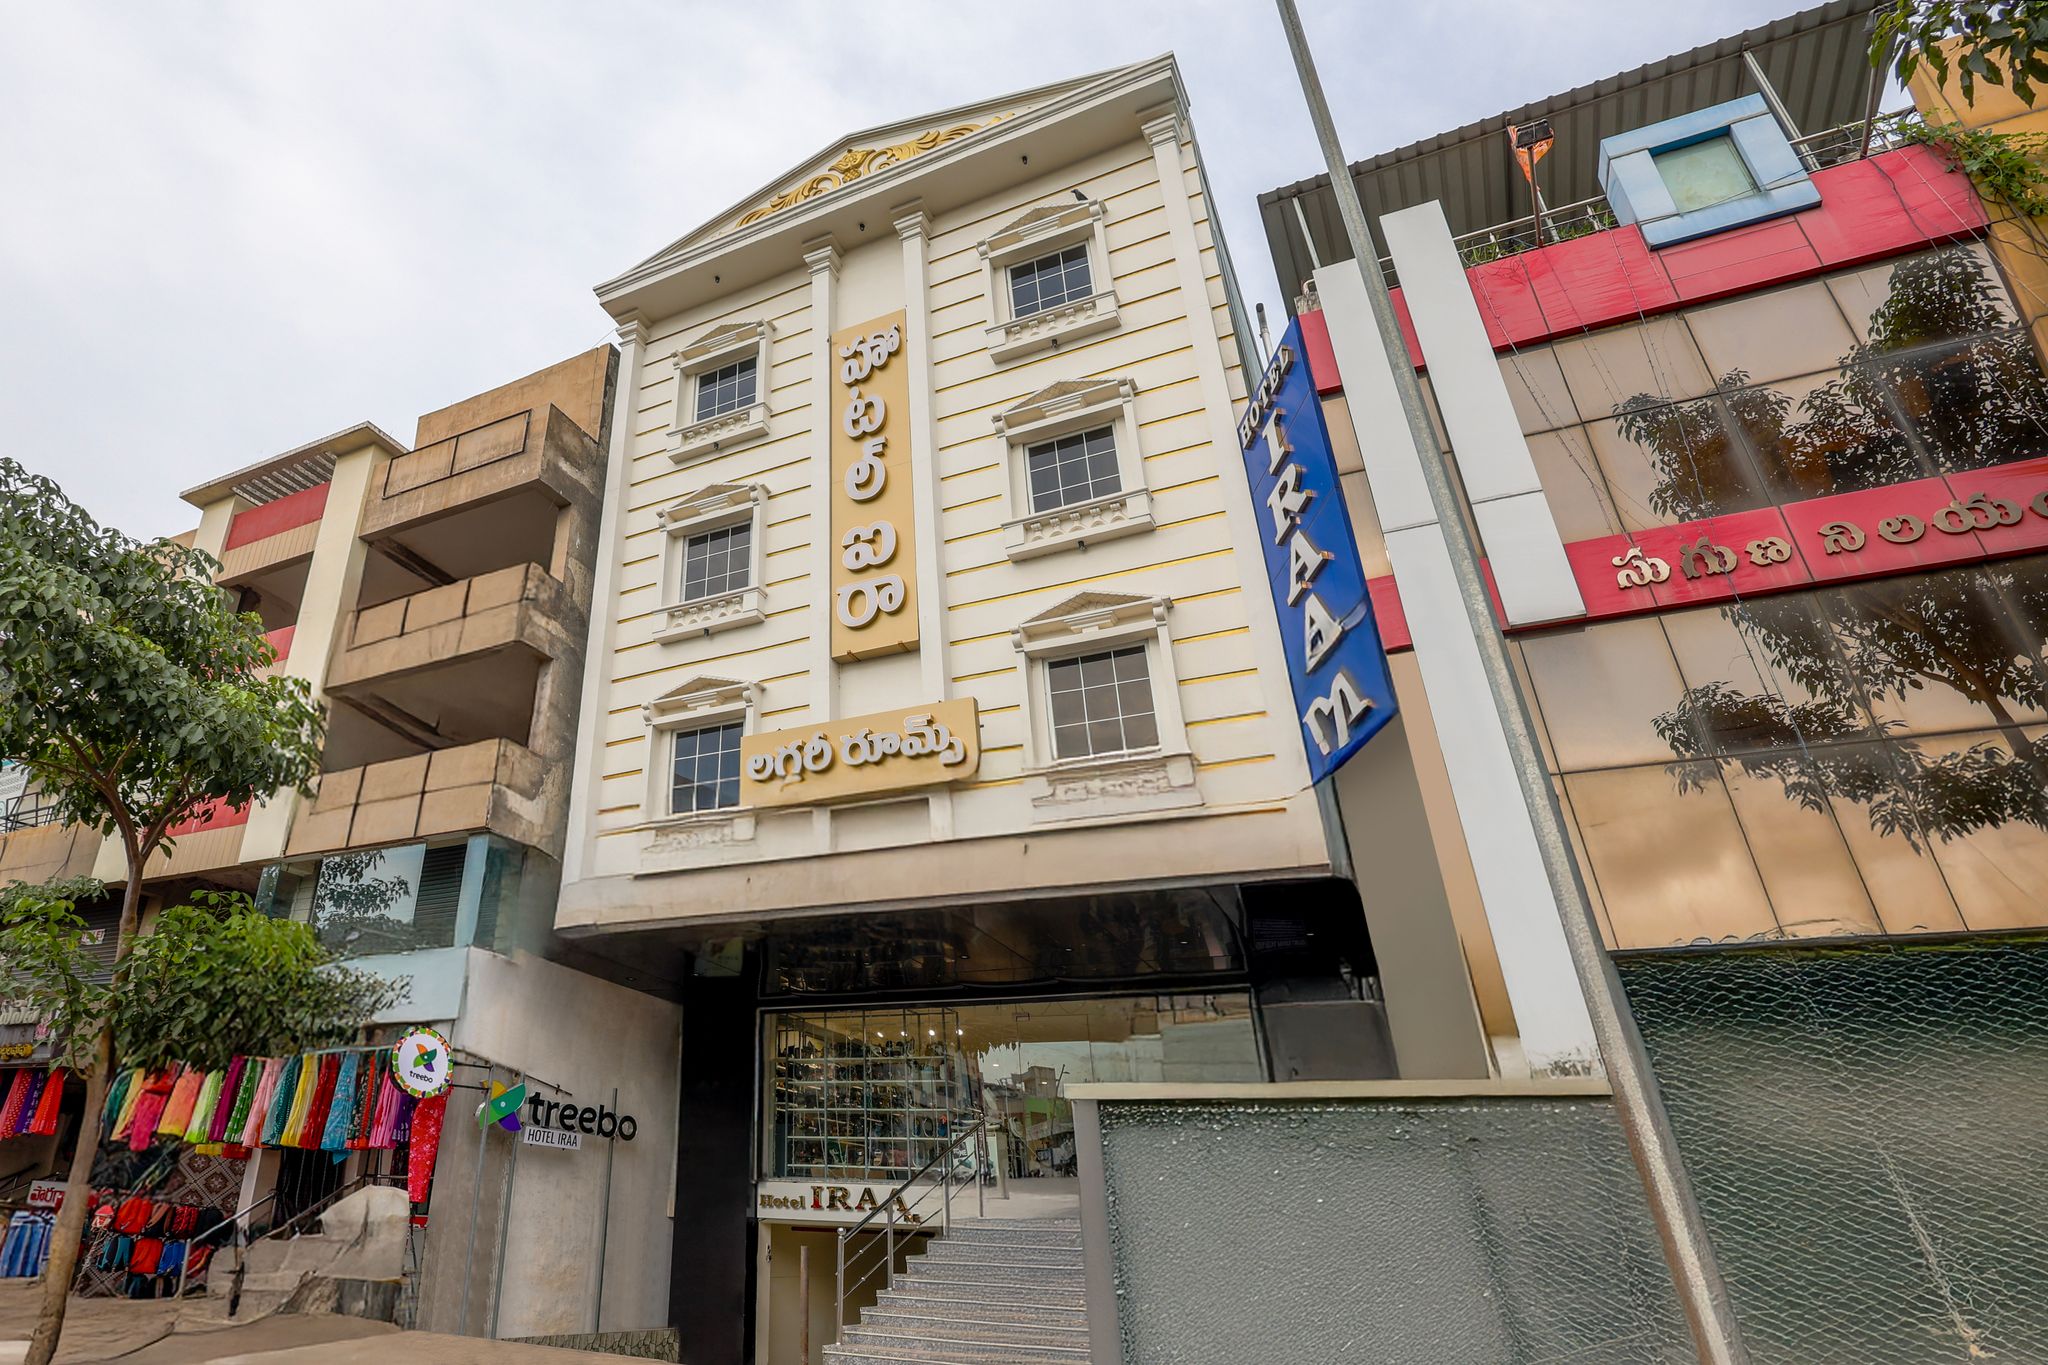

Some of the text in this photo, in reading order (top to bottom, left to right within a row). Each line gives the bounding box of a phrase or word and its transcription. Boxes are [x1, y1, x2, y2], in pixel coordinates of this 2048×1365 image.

[1239, 345, 1294, 450] HOTEL
[1611, 535, 1793, 590] సుగుణ
[409, 1070, 434, 1084] treebo
[526, 1091, 638, 1142] treebo
[527, 1128, 578, 1148] HOTEL IRAA
[758, 1193, 807, 1210] Hotel
